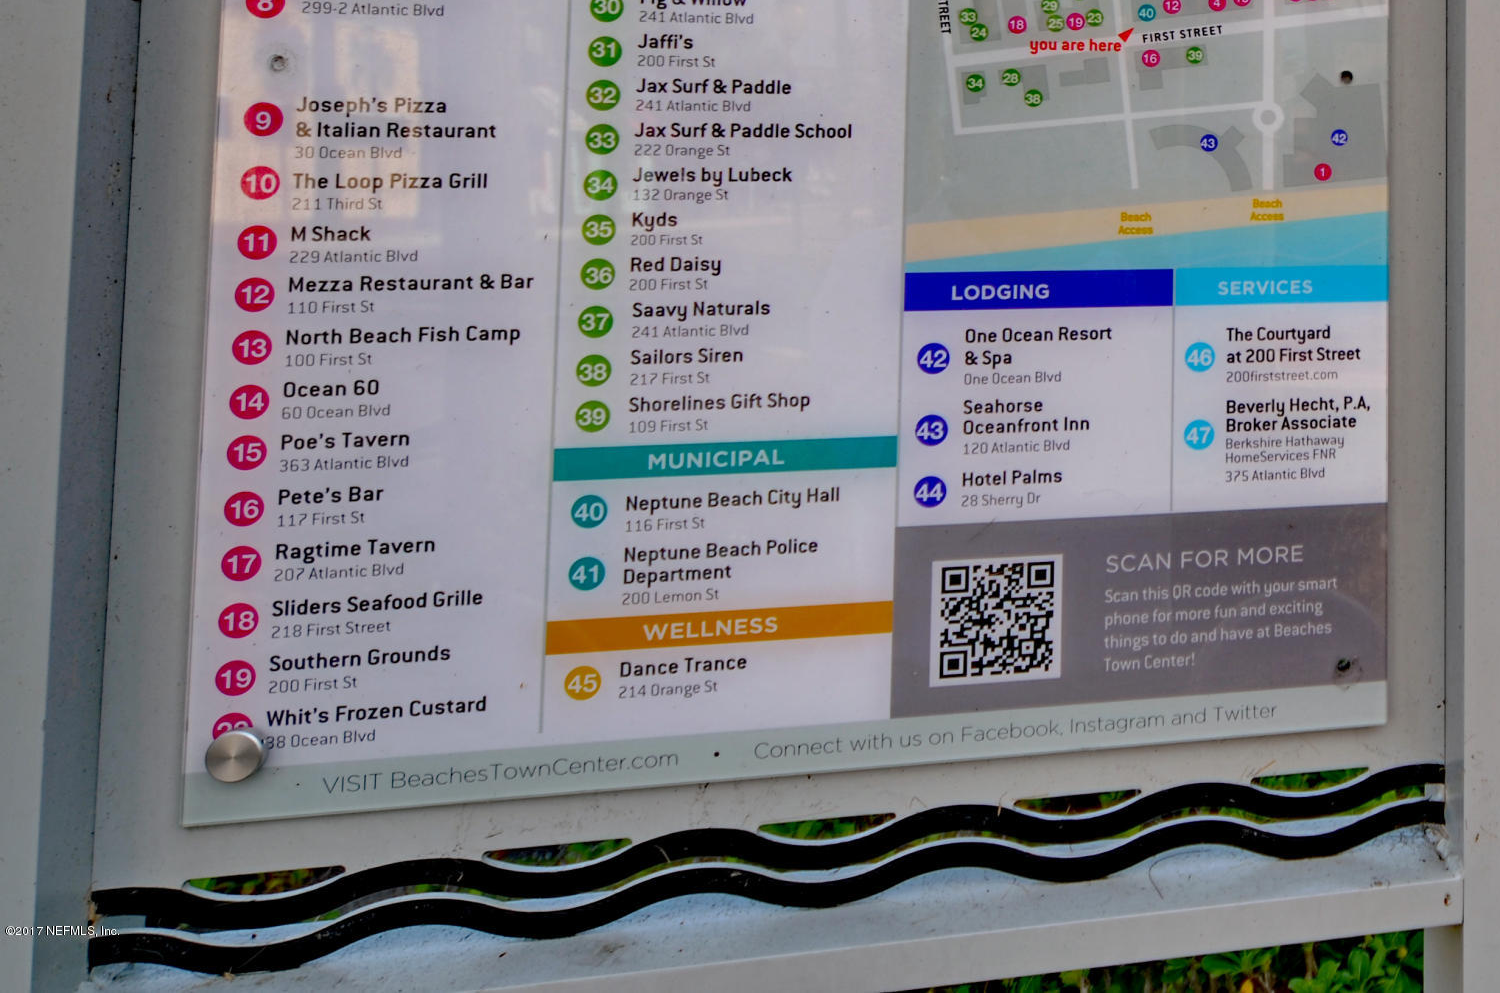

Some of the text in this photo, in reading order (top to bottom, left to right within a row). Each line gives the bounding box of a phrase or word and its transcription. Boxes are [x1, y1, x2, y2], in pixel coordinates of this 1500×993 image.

[301, 2, 444, 16] 299-2 Atlantic Blvd
[638, 34, 694, 49] Jaffi's
[1143, 25, 1223, 42] FIRST STREET
[1030, 38, 1121, 54] you are here
[1253, 199, 1282, 208] Beach
[632, 213, 677, 232] Kyds
[1120, 212, 1151, 222] Beach
[1250, 212, 1284, 221] Access
[1118, 226, 1153, 235] Access
[630, 257, 721, 276] Red Daisy
[951, 284, 1050, 301] LODGING
[1218, 280, 1313, 295] SERVICES
[965, 326, 1112, 343] One Ocean Resort
[1226, 326, 1331, 345] The Courtyard
[920, 350, 1012, 368] 42 & Spa
[1227, 347, 1361, 363] at 200 First Street
[1226, 369, 1338, 383] 200firststreet.com
[964, 399, 1043, 414] Seahorse
[1226, 399, 1285, 416] Beverly
[1289, 397, 1340, 414] Hecht,
[963, 417, 1089, 435] Oceanfront Inn
[1226, 415, 1357, 432] Broker Associate
[281, 433, 410, 450] Poe's Tavern
[648, 450, 784, 470] MUNICIPAL
[962, 469, 1062, 487] Hotel Palms
[575, 487, 840, 521] 40 Neptune Beach City Hall
[276, 539, 435, 563] Ragtime Tavern
[1106, 545, 1303, 573] SCAN FOR MORE
[1105, 578, 1337, 603] Scan this QR code with your smart
[644, 617, 778, 641] WELLNESS
[1105, 653, 1195, 672] Town Center!
[568, 657, 747, 692] 45 Dance Trance
[266, 696, 487, 727] Whit's Frozen Custard
[754, 704, 1277, 759] Connect with us on Facebook, Instagram and Twitter
[323, 752, 679, 794] VISIT BeachesTownCenter.com
